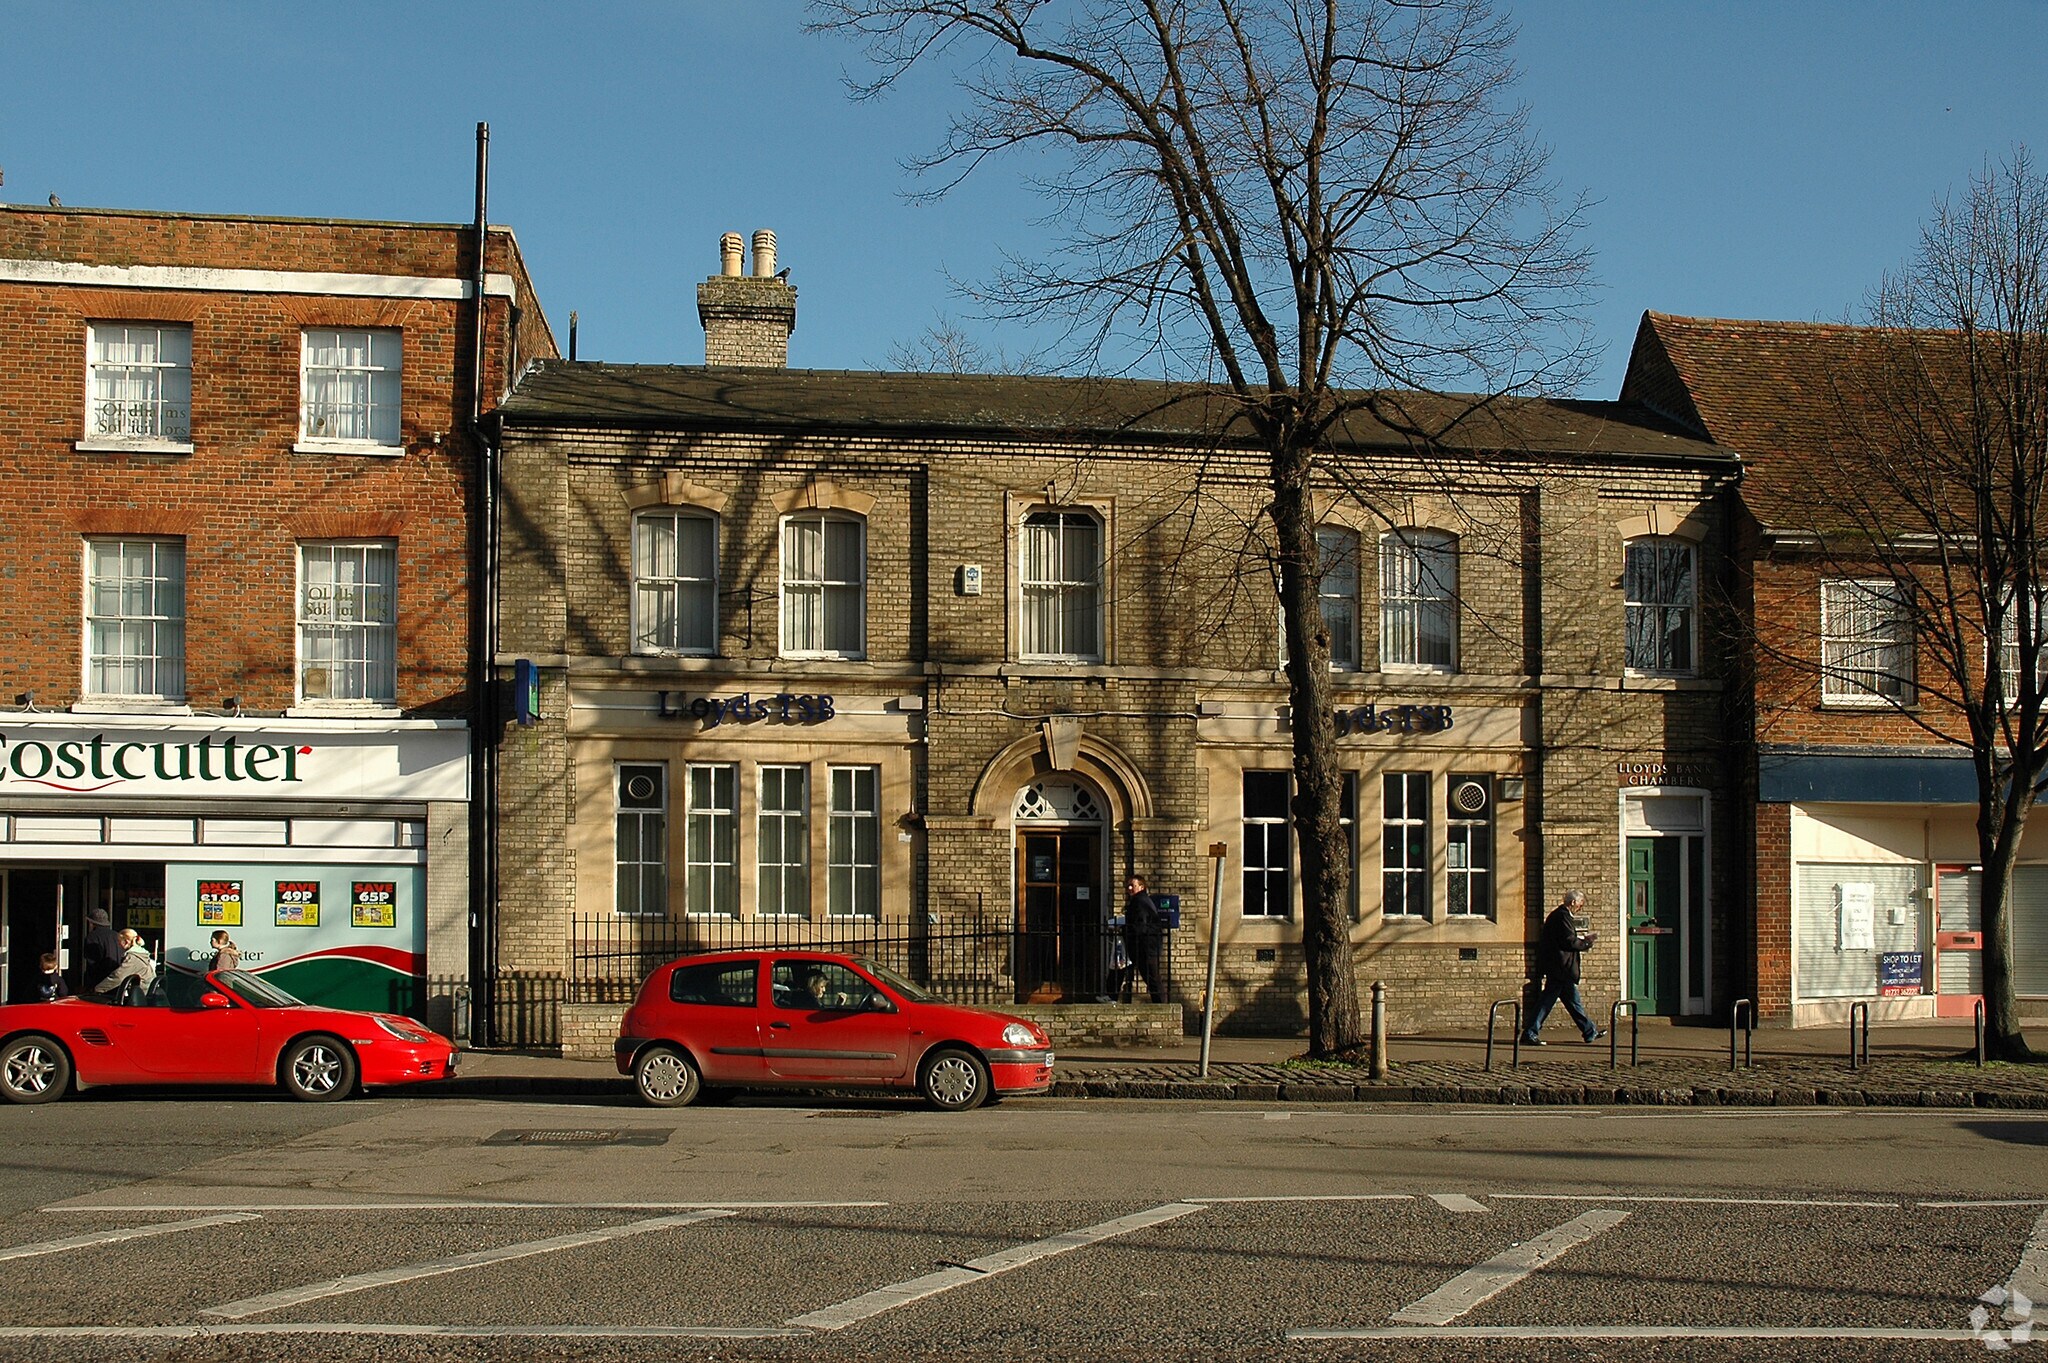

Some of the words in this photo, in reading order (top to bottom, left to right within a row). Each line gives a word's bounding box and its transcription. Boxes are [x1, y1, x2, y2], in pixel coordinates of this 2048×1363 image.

[776, 693, 836, 721] TSB
[1398, 705, 1454, 731] TSB
[0, 733, 312, 782] ostcutter
[1618, 762, 1668, 774] LLOYDS
[1676, 764, 1713, 774] BANK
[1629, 775, 1702, 786] CHAMBERS
[231, 882, 241, 890] 2
[278, 883, 317, 892] SAVE
[354, 883, 393, 893] SAVE
[200, 893, 240, 902] £1.00
[1883, 955, 1899, 964] SHOP
[1900, 955, 1909, 963] TO
[1910, 955, 1922, 963] LET
